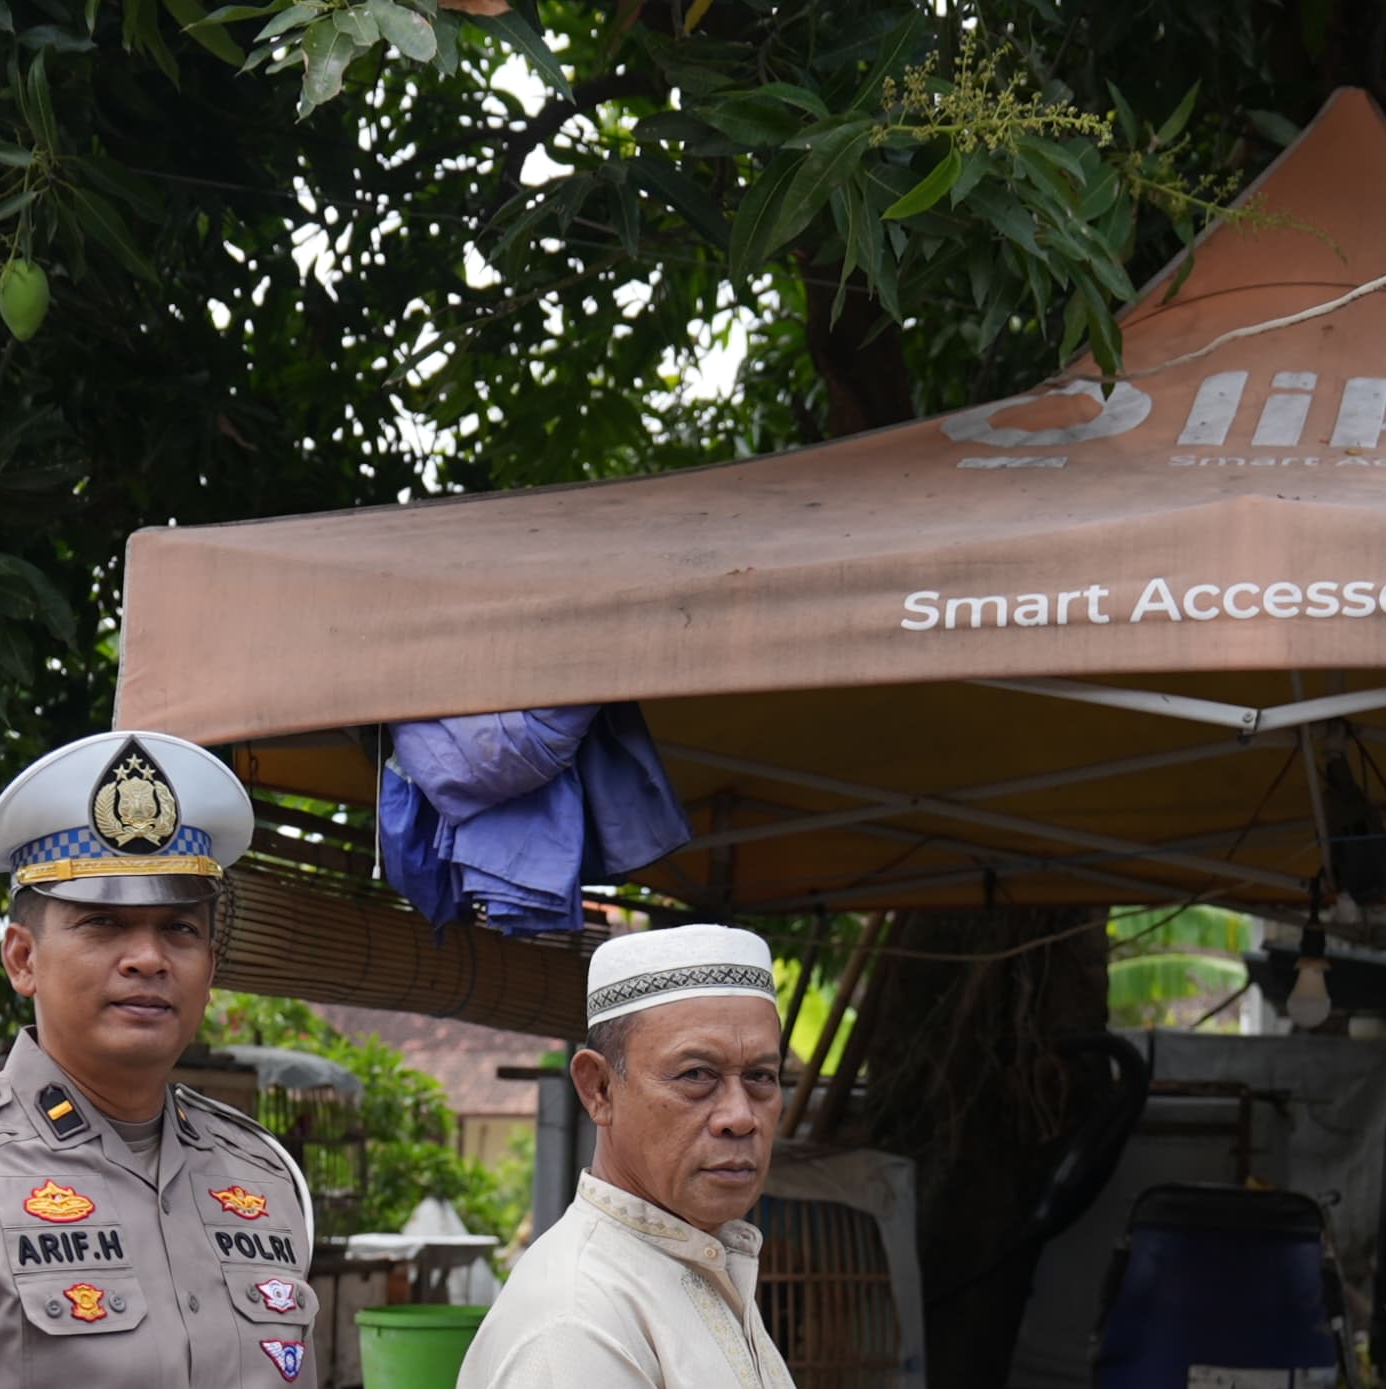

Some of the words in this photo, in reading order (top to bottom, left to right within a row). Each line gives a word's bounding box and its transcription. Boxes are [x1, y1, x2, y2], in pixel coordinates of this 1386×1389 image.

[900, 583, 1109, 631] Smart
[19, 1230, 124, 1266] ARIF.H
[215, 1231, 297, 1264] POLRI
